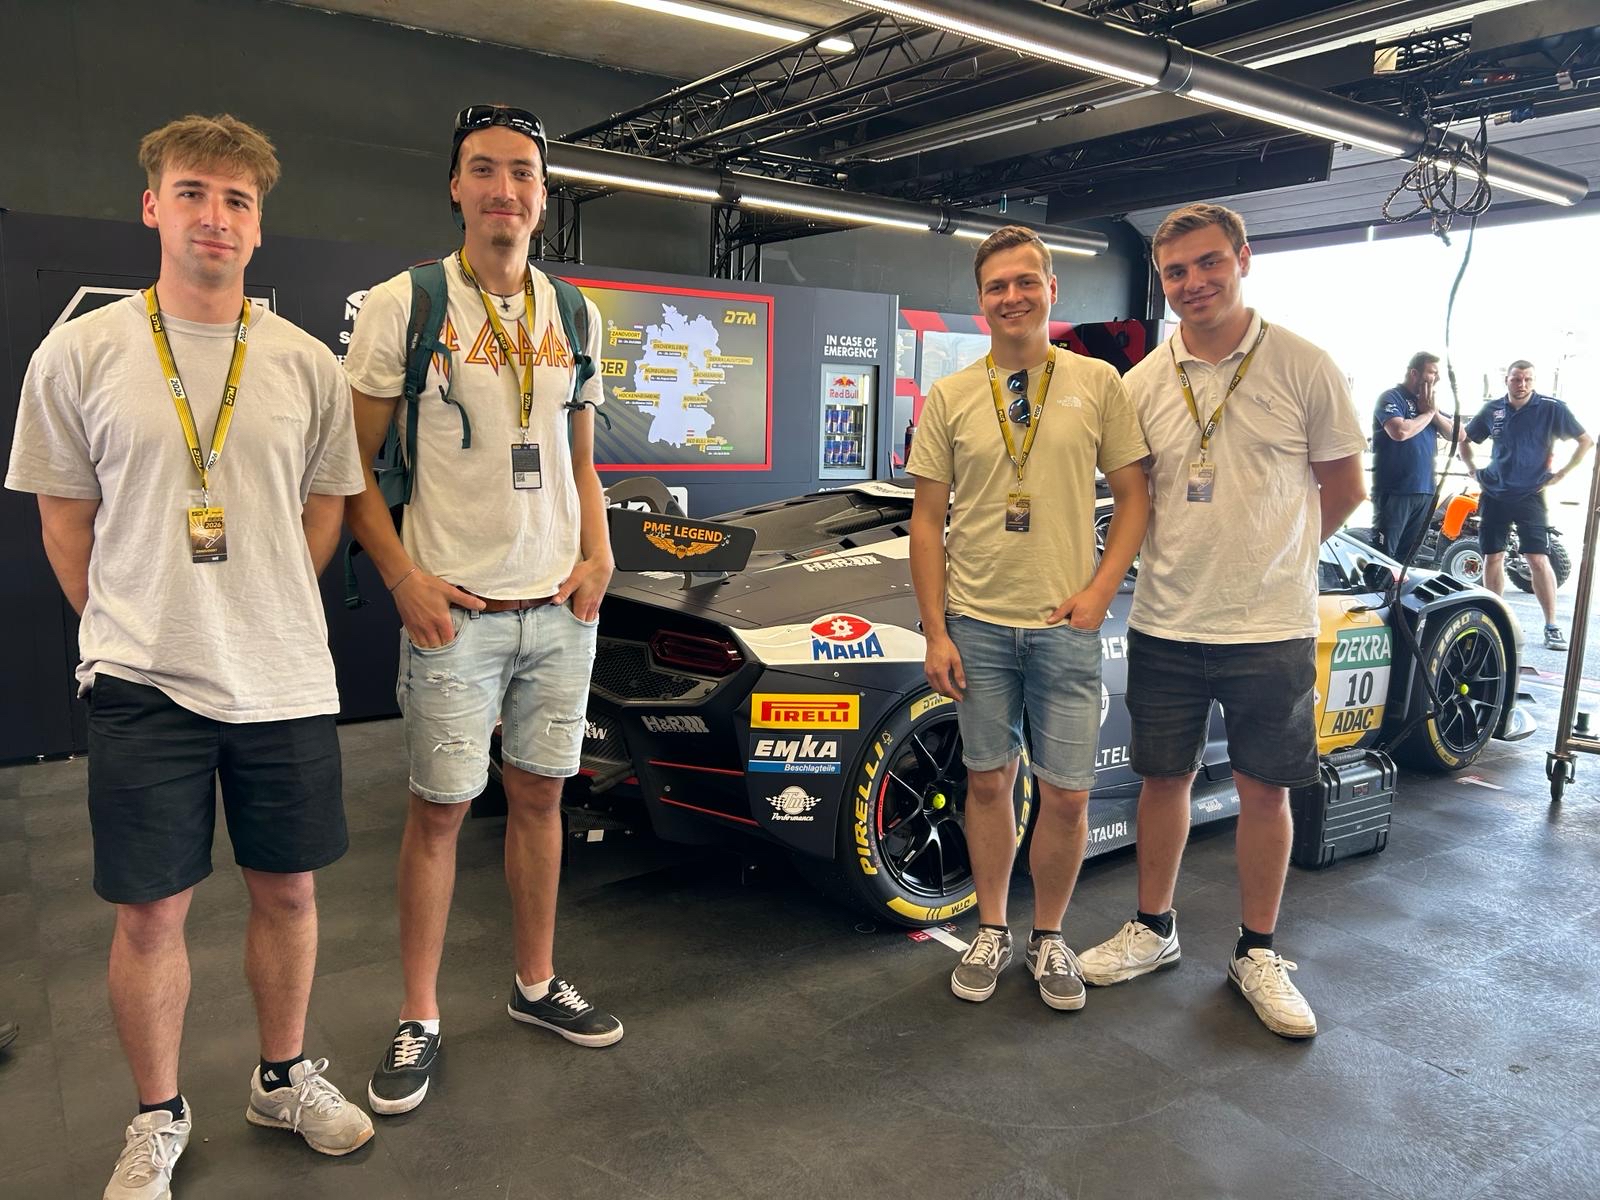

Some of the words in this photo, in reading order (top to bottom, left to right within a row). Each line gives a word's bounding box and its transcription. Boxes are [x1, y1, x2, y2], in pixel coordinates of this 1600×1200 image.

[151, 314, 162, 333] DTM
[724, 311, 757, 326] DTM
[826, 335, 837, 345] IN
[839, 336, 862, 347] CASE
[865, 338, 877, 348] OF
[824, 346, 878, 359] EMERGENCY
[170, 379, 183, 398] 2026
[225, 386, 237, 406] DTM
[643, 520, 672, 536] PME
[674, 524, 723, 543] LEGEND
[813, 632, 884, 661] MAHA
[1333, 633, 1391, 664] DEKRA
[1345, 671, 1374, 707] 10
[761, 701, 850, 722] PIRELLI
[1332, 708, 1374, 734] ADAC
[784, 763, 836, 774] Beschlagteile
[855, 742, 885, 875] PIRELLI
